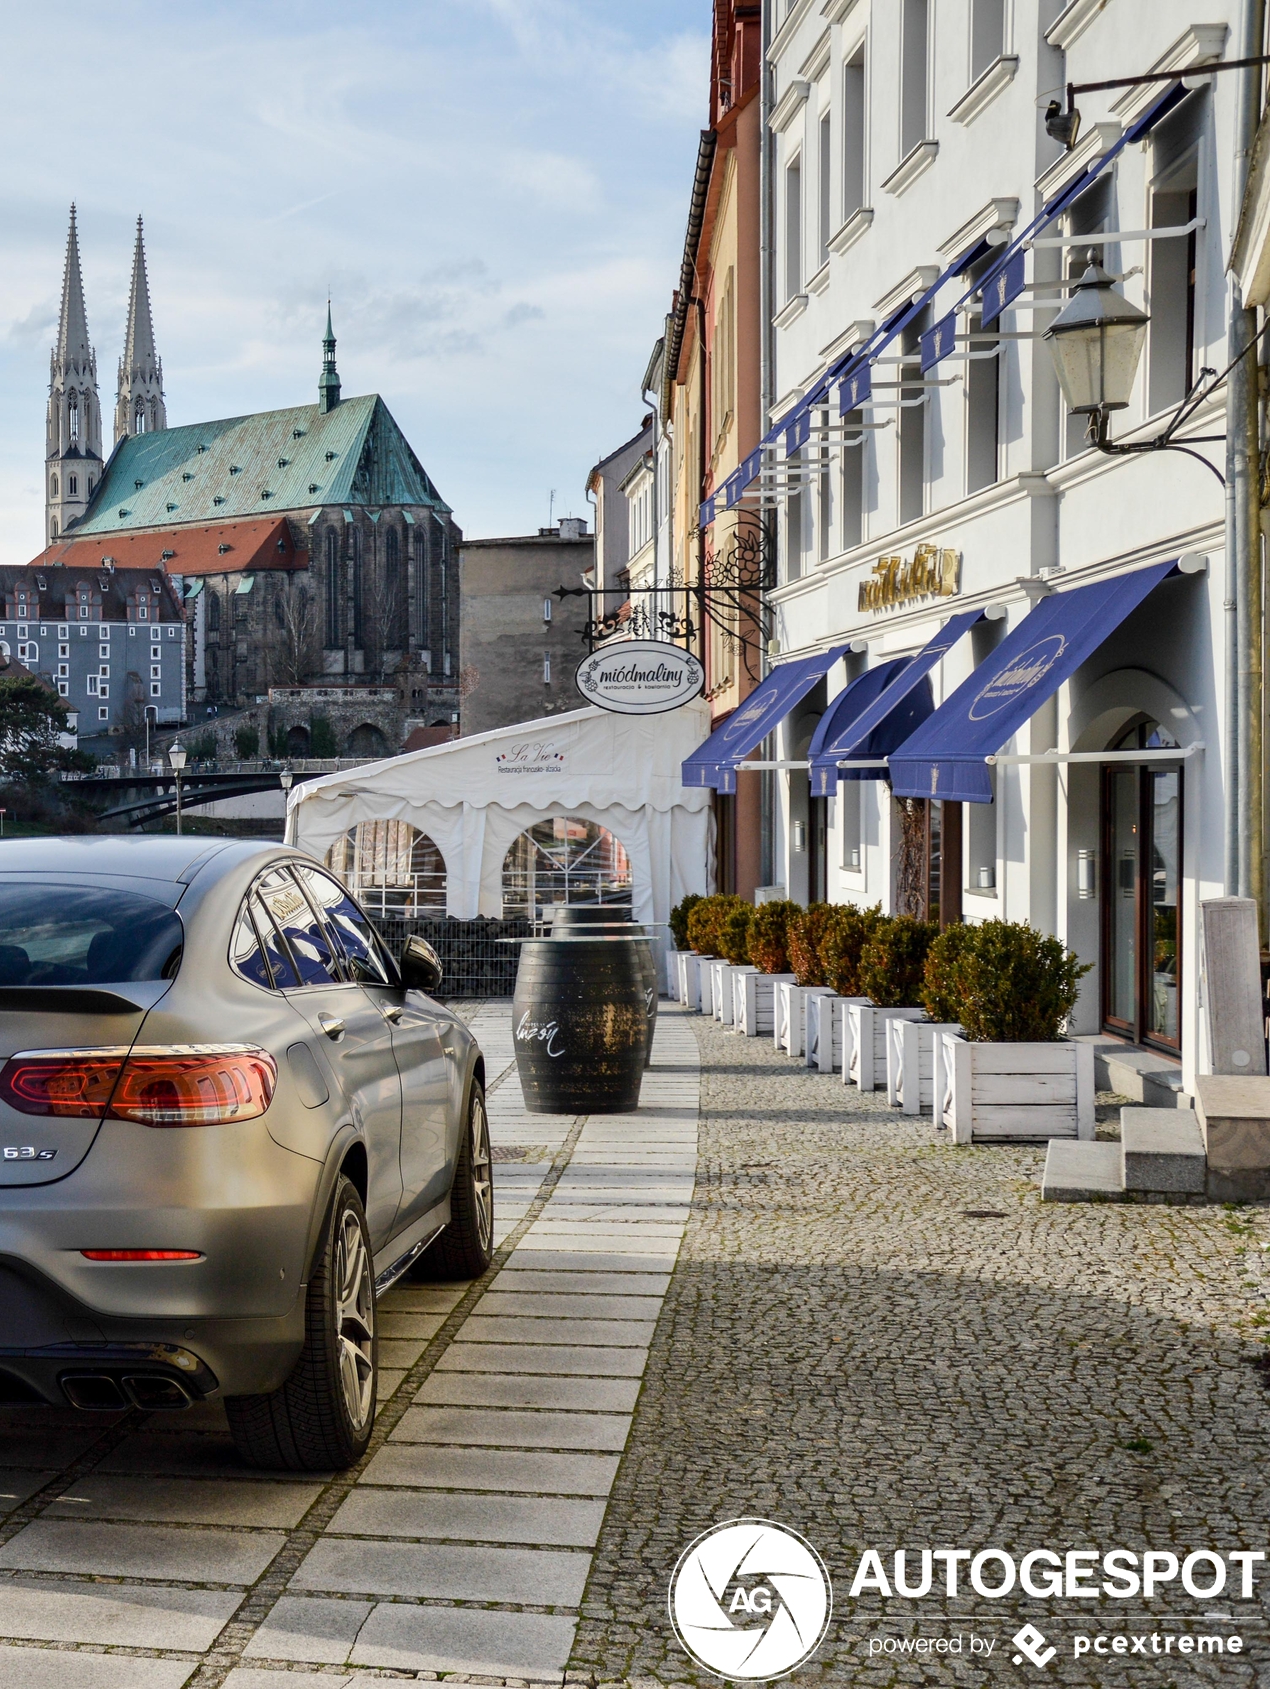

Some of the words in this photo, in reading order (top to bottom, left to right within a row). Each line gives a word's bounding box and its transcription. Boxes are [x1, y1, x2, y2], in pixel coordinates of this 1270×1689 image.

[600, 663, 683, 688] miódmaliny
[507, 744, 529, 763] La
[533, 743, 554, 762] Vie
